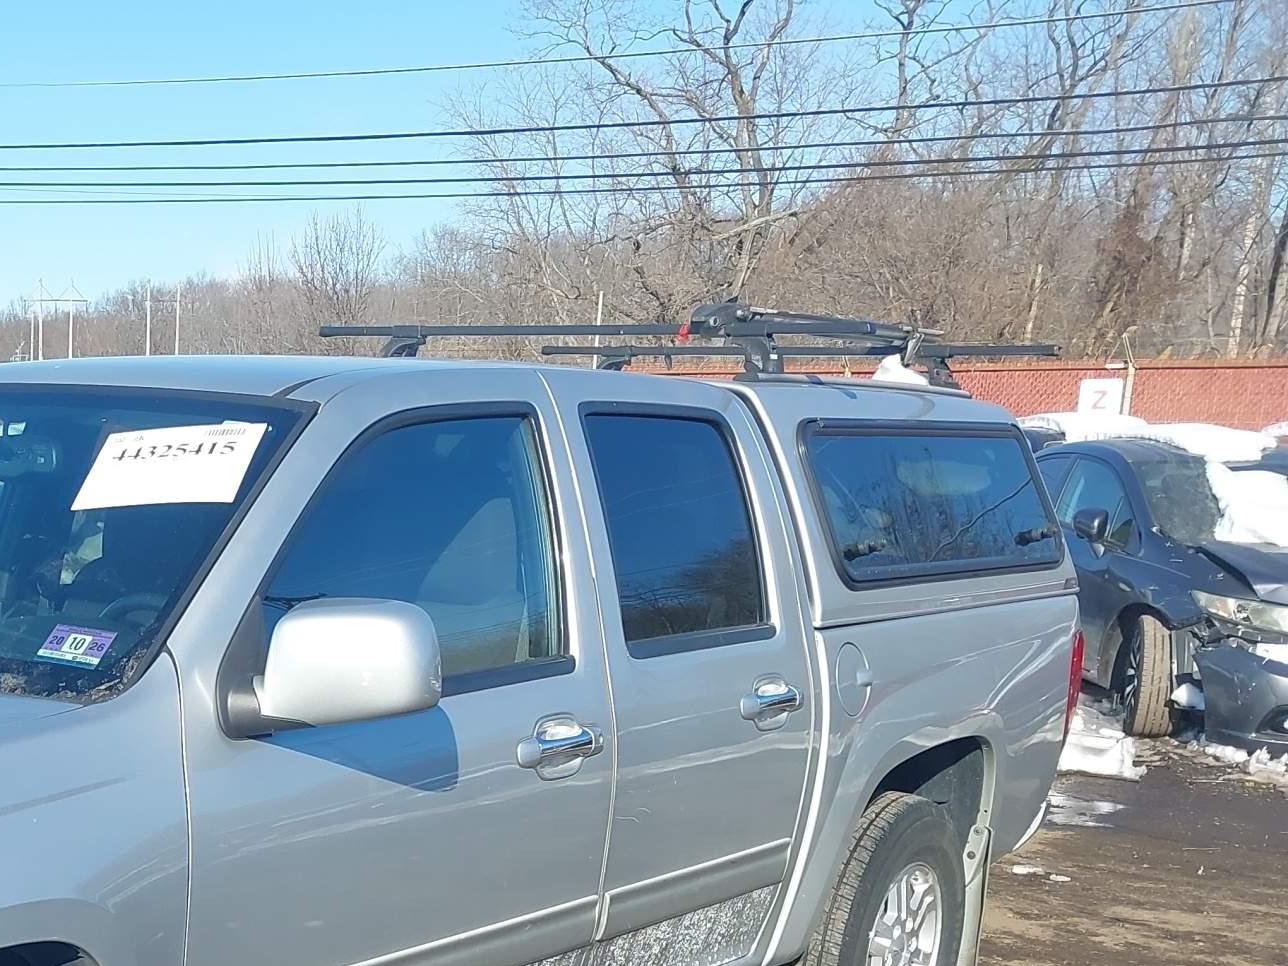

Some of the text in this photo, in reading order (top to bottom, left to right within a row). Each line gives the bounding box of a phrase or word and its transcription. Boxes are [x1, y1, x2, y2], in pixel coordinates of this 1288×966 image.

[1091, 390, 1108, 410] Z
[112, 441, 238, 462] 44325415
[48, 635, 106, 652] 20 10 26
